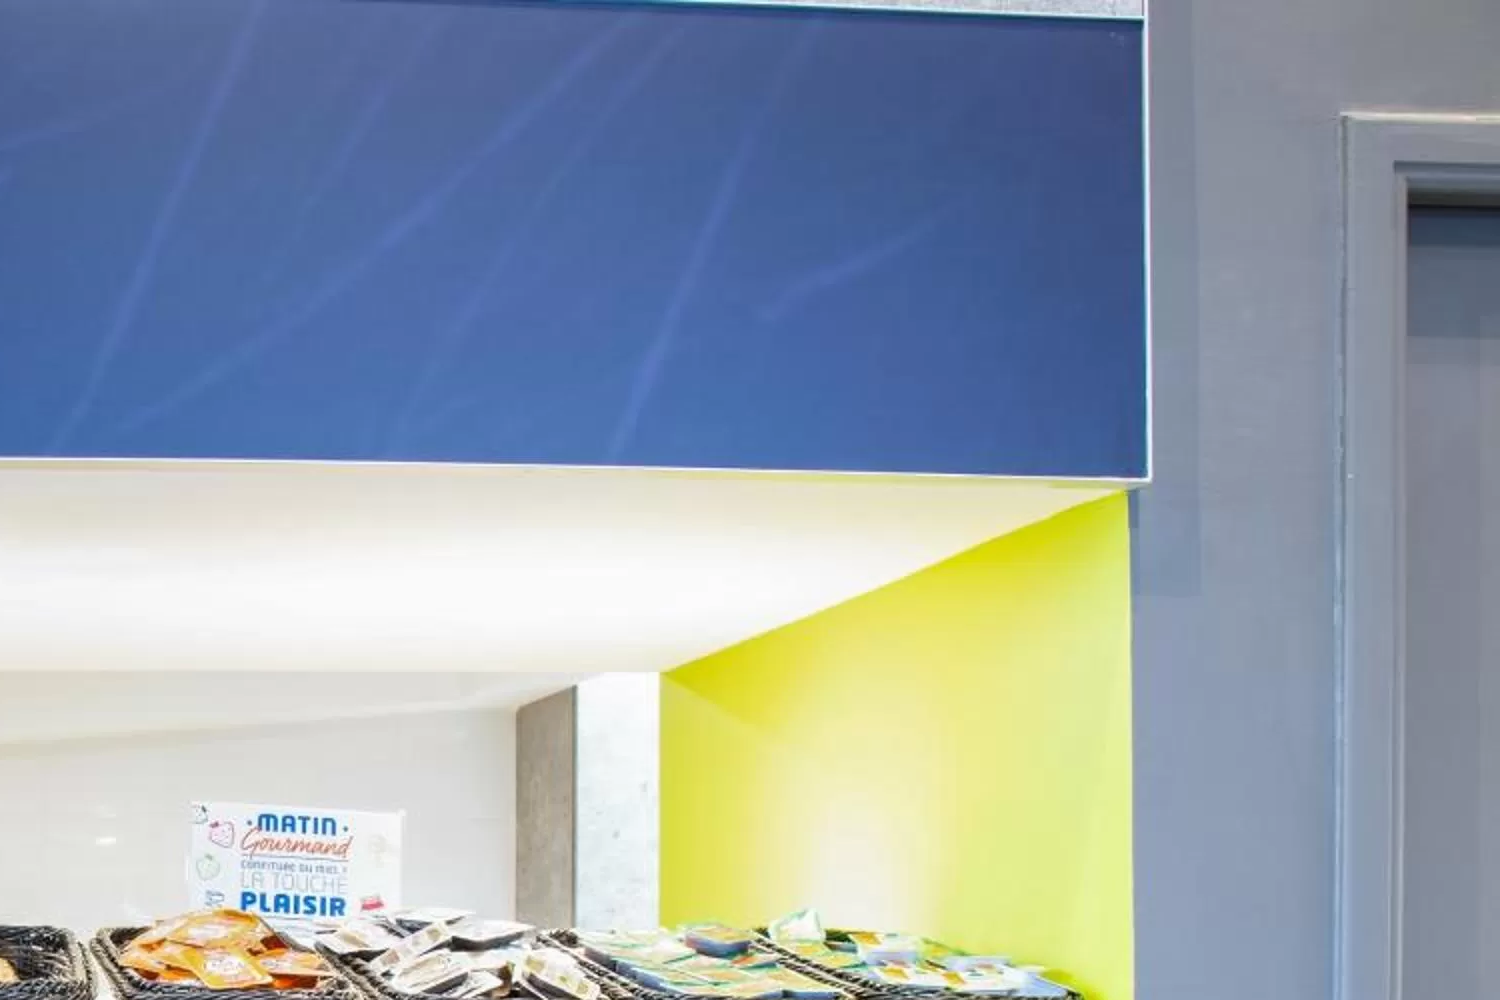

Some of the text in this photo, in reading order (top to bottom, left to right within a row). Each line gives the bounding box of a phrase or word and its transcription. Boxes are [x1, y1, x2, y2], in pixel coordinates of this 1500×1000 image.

[257, 813, 337, 836] MATIN
[241, 827, 354, 861] Gourmand
[241, 869, 349, 896] LA TOUCHE
[240, 891, 347, 917] PLAISIR
